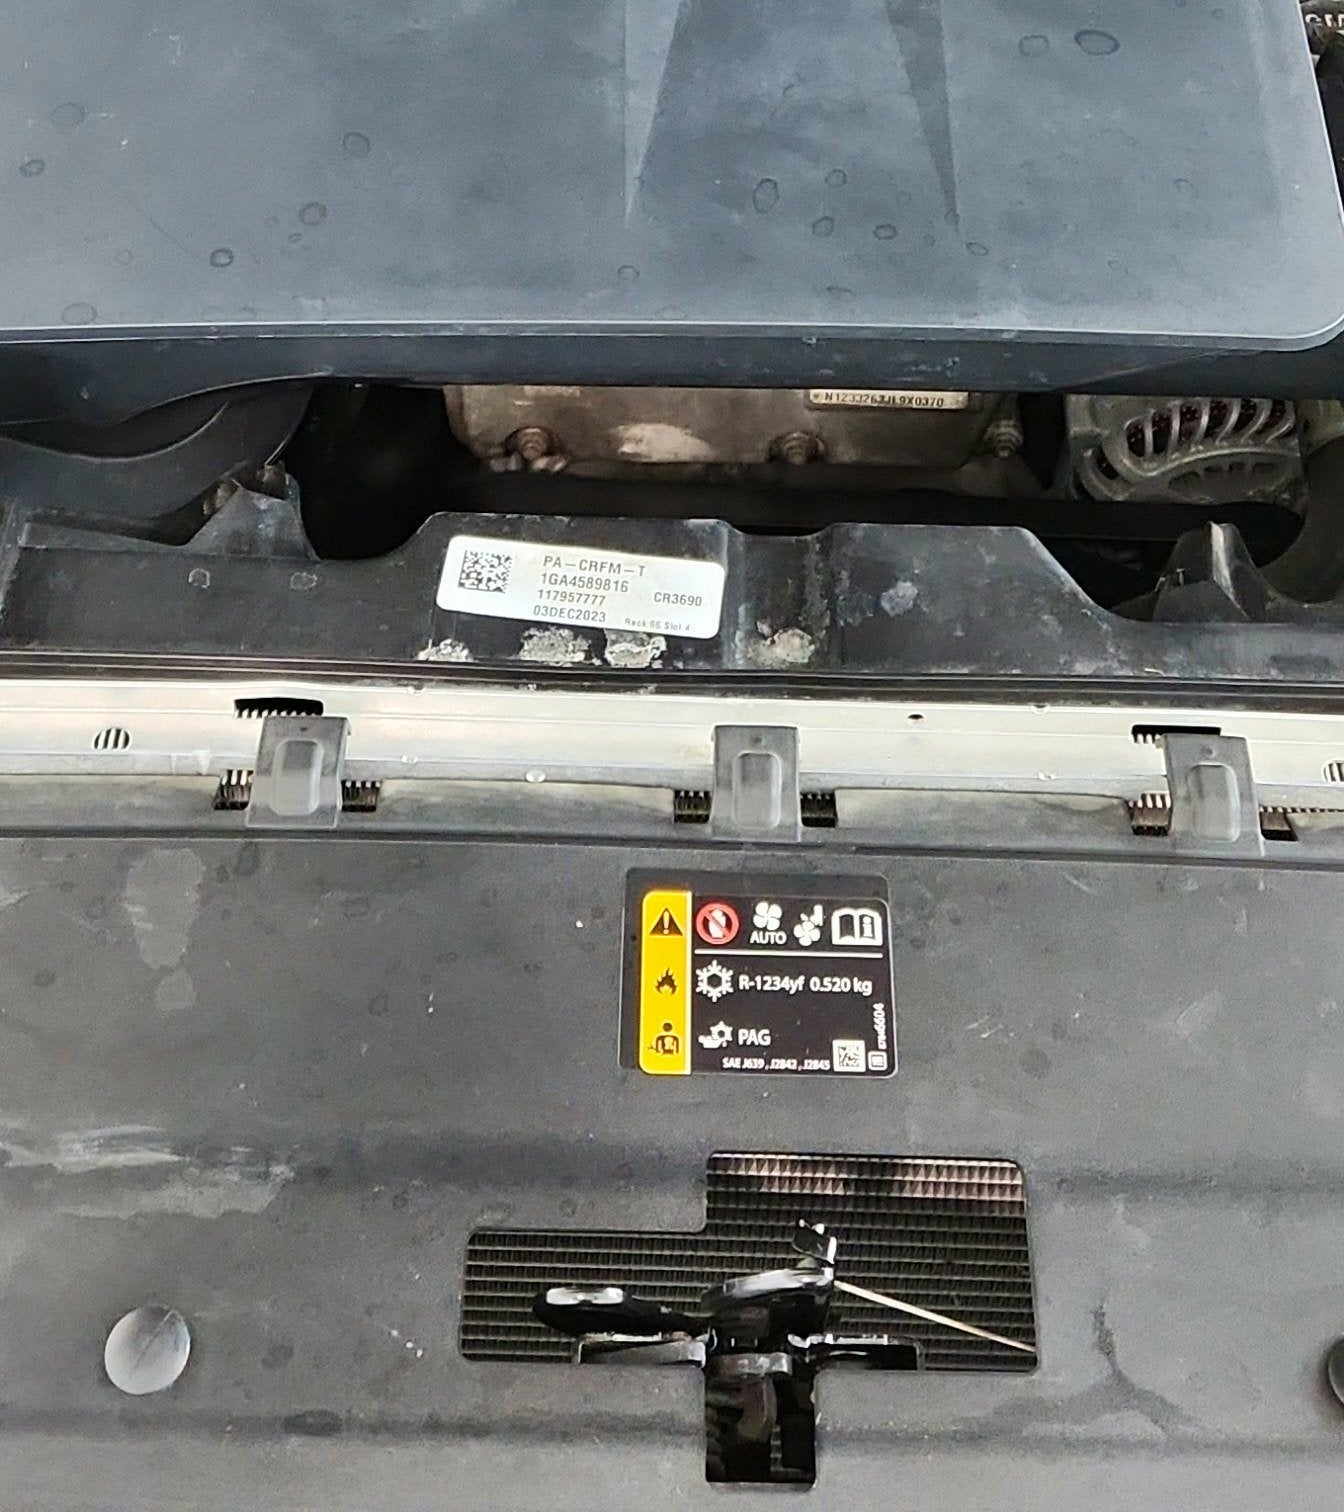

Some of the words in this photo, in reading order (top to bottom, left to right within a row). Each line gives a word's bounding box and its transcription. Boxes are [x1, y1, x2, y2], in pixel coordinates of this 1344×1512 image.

[541, 572, 630, 593] 1GA4589816
[537, 589, 607, 607] 117957777
[653, 591, 703, 607] CR3690
[532, 604, 607, 623] 03DEC2023
[749, 930, 788, 945] AUTO
[738, 975, 805, 995] R-1234yf
[809, 976, 851, 993] 0.520
[852, 977, 873, 996] kg
[737, 1029, 771, 1046] PAG
[722, 1057, 741, 1068] SAE
